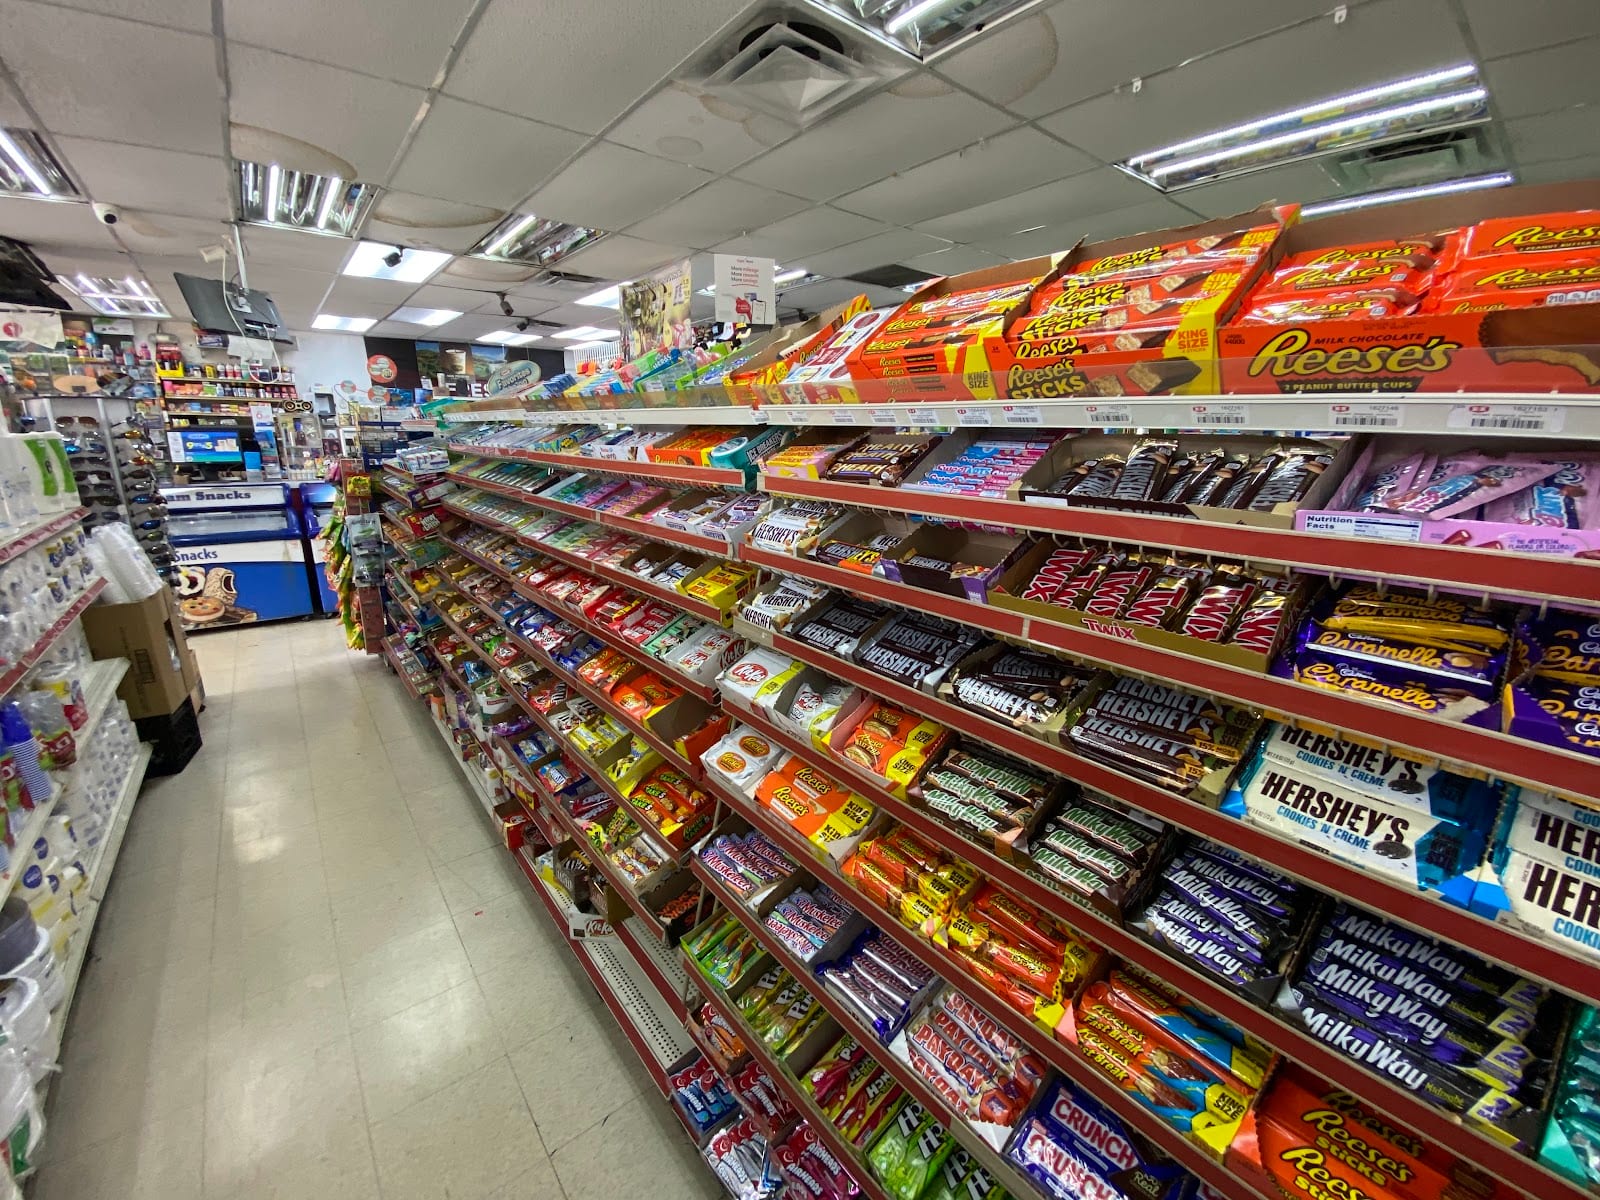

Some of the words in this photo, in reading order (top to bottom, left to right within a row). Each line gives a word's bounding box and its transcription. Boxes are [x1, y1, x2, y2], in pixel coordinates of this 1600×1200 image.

[1177, 328, 1208, 341] KING
[1178, 338, 1210, 350] SIZE
[1314, 336, 1345, 344] MILK
[1348, 333, 1424, 344] CHOCOLATE
[1249, 328, 1462, 376] Reese's
[968, 371, 988, 380] KING
[969, 380, 990, 388] SIZE
[1292, 382, 1334, 392] PEANUT
[1336, 382, 1379, 390] BUTTER
[1382, 382, 1414, 390] CUPS
[195, 490, 252, 500] Snacks
[754, 522, 799, 545] HERSHEY'S
[1306, 515, 1353, 524] Nutrition
[1306, 522, 1334, 530] Facts
[174, 548, 218, 562] Snacks
[1023, 548, 1097, 602] TWIX
[884, 624, 952, 658] HERSHEY'S
[1316, 631, 1443, 670] Caramello
[862, 644, 932, 680] HERSHEY'S
[1303, 663, 1438, 711] Caramello
[795, 766, 832, 795] Reese's
[1296, 750, 1335, 771] COOKIES
[1350, 768, 1386, 788] CREME
[772, 785, 809, 817] Reese's
[1260, 772, 1410, 844] HERSHEY'S
[1276, 805, 1317, 828] COOKIES
[1333, 826, 1371, 851] CREME
[1084, 1014, 1110, 1033] Fast
[1108, 1026, 1144, 1056] Break
[913, 1024, 984, 1090] PAYDAY
[1095, 1052, 1130, 1082] Break
[1214, 1100, 1238, 1120] SIZE
[1218, 1092, 1246, 1111] KING
[1054, 1098, 1136, 1168] CRUNCH
[1302, 1109, 1414, 1183] Reese's
[806, 1142, 841, 1176] AIRHEADS
[1314, 1136, 1386, 1187] sticks
[786, 1162, 823, 1196] AIRHEADS
